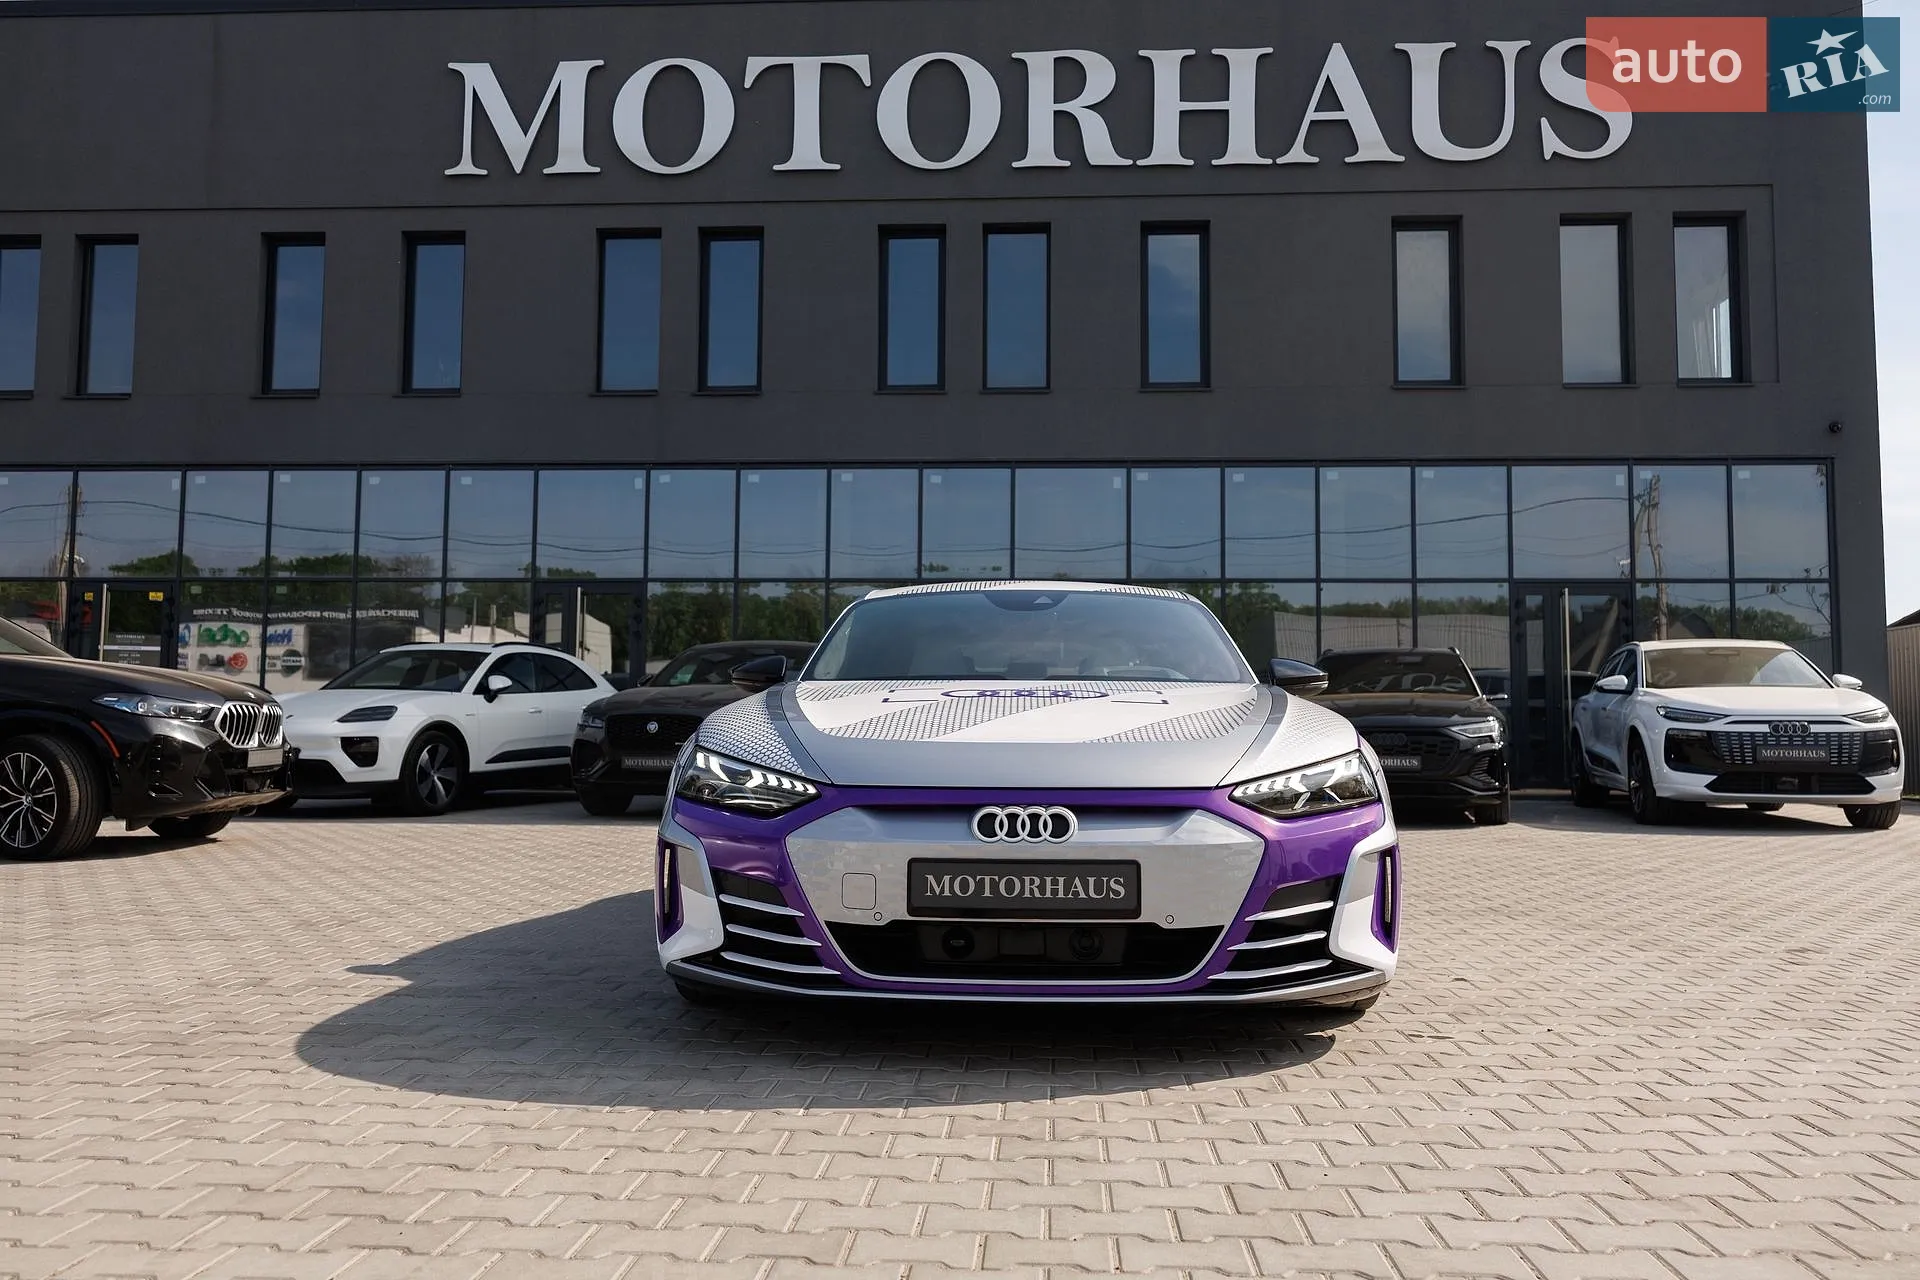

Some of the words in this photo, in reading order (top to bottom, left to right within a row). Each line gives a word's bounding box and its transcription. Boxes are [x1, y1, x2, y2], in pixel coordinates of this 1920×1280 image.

[443, 36, 1634, 176] MOTORHAUS
[1762, 749, 1826, 758] MOTORHAUS
[624, 758, 675, 767] MOTORHAUS
[1380, 758, 1419, 767] ORHAUS
[924, 874, 1126, 900] MOTORHAUS
